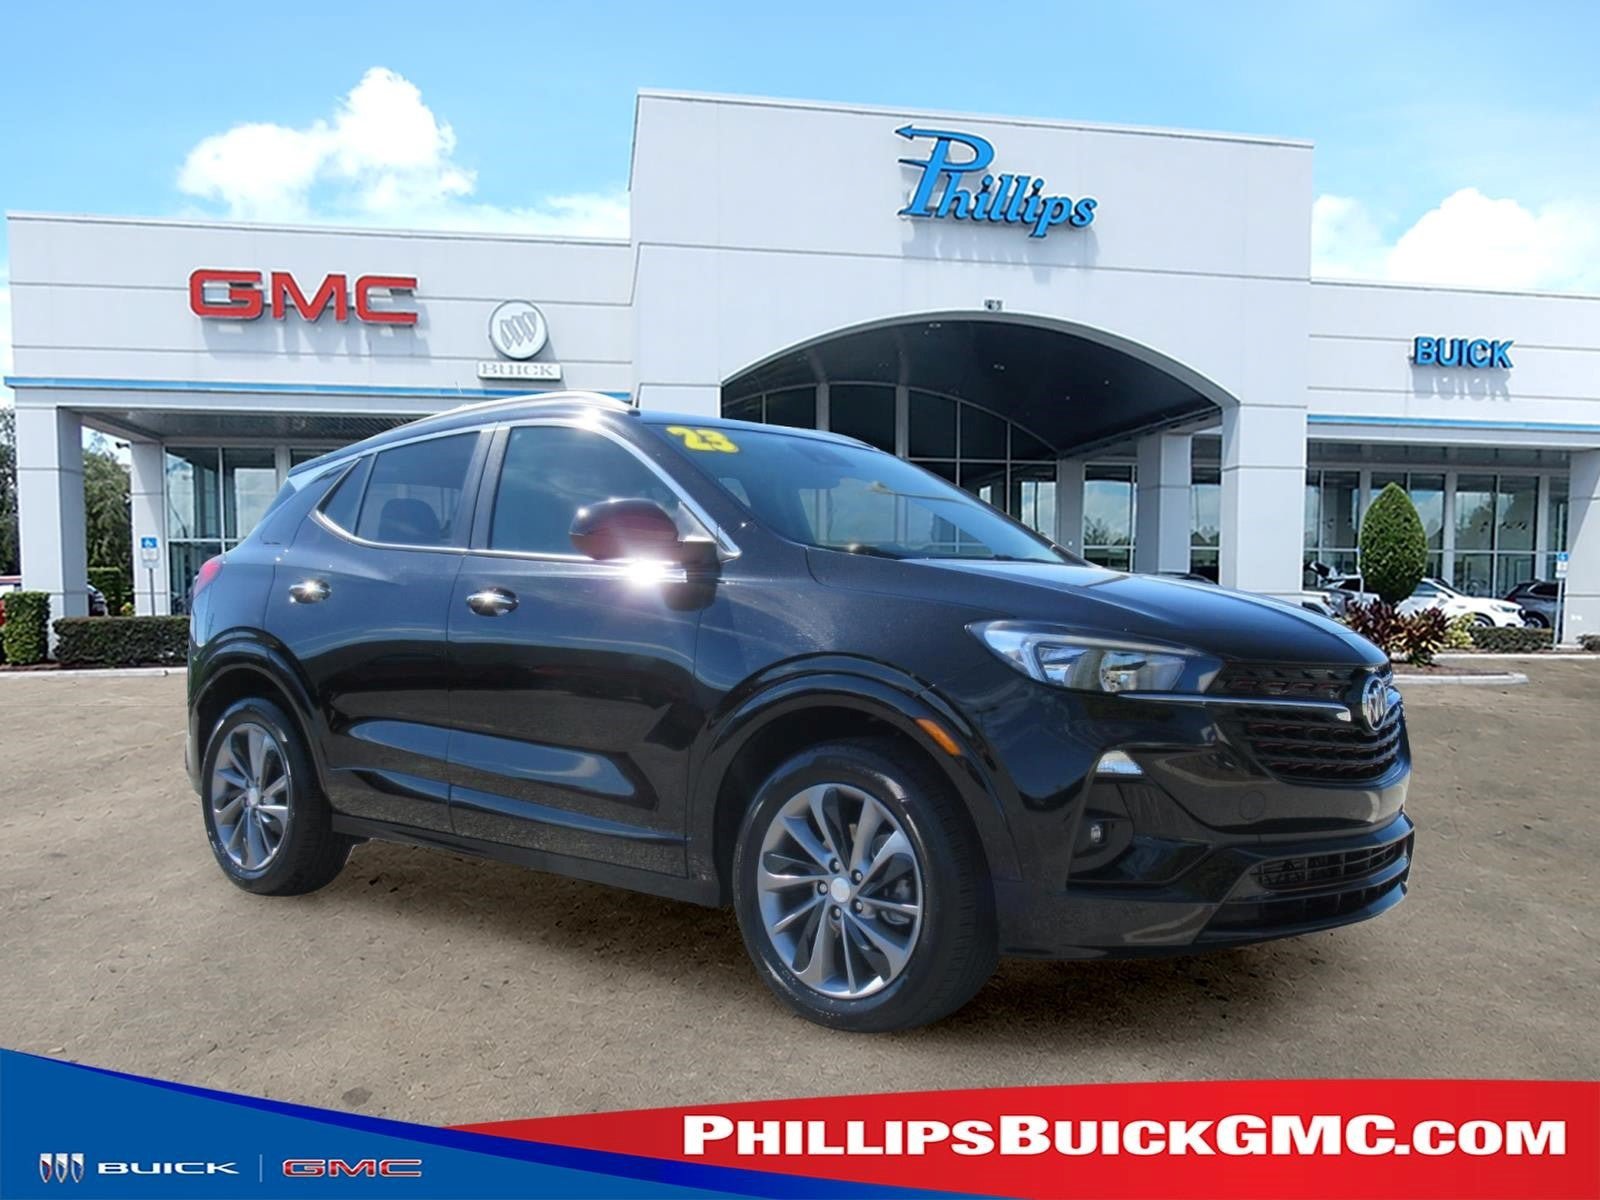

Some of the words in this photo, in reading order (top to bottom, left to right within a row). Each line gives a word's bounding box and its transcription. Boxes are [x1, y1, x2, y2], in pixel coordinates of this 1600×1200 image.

[895, 125, 1098, 238] Phillips
[189, 269, 418, 326] GMC
[1414, 336, 1514, 368] BUICK
[482, 363, 553, 376] BUICK
[666, 426, 738, 453] 23
